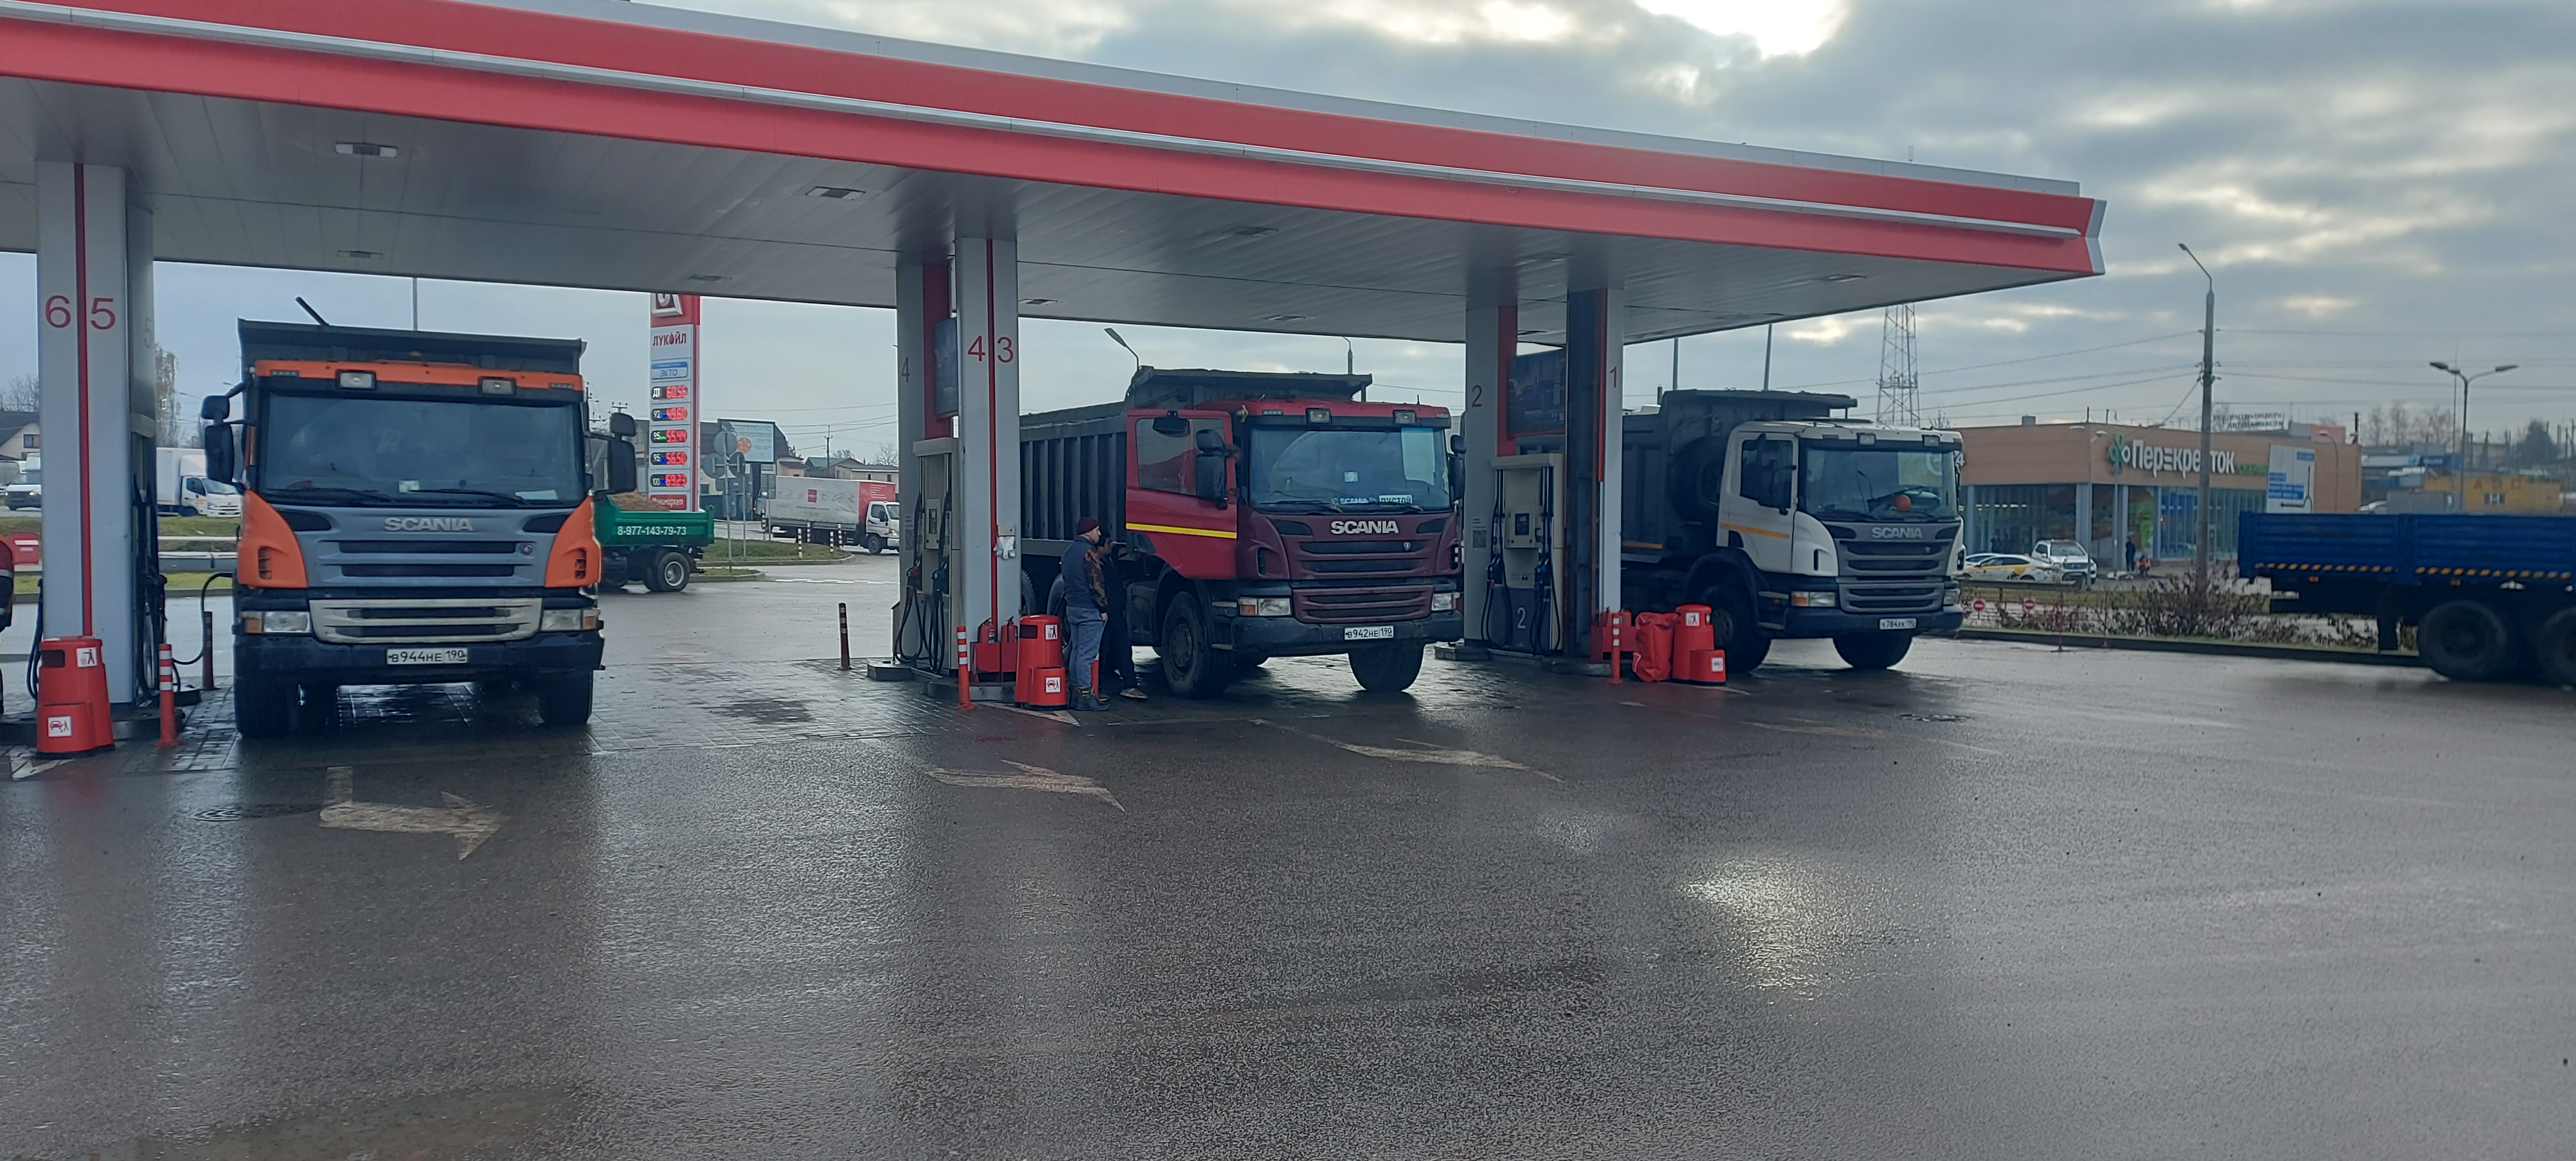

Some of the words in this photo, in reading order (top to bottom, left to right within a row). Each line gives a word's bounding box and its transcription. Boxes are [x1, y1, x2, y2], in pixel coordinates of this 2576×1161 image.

[45, 295, 71, 328] 6
[90, 297, 115, 330] 5
[652, 331, 686, 346] ЛУКОЙЛ
[968, 335, 985, 362] 4
[997, 336, 1014, 363] 3
[660, 368, 677, 377] ЭКТО
[901, 357, 910, 383] 4
[1609, 366, 1617, 388] 1
[1471, 384, 1482, 407] 2
[2132, 439, 2235, 479] Перекреток
[384, 517, 474, 531] SCANIA
[617, 526, 686, 535] 8-977-143-79-73
[1330, 520, 1399, 534] SCANIA
[1871, 526, 1923, 539] SCANIA
[1517, 607, 1526, 629] 2
